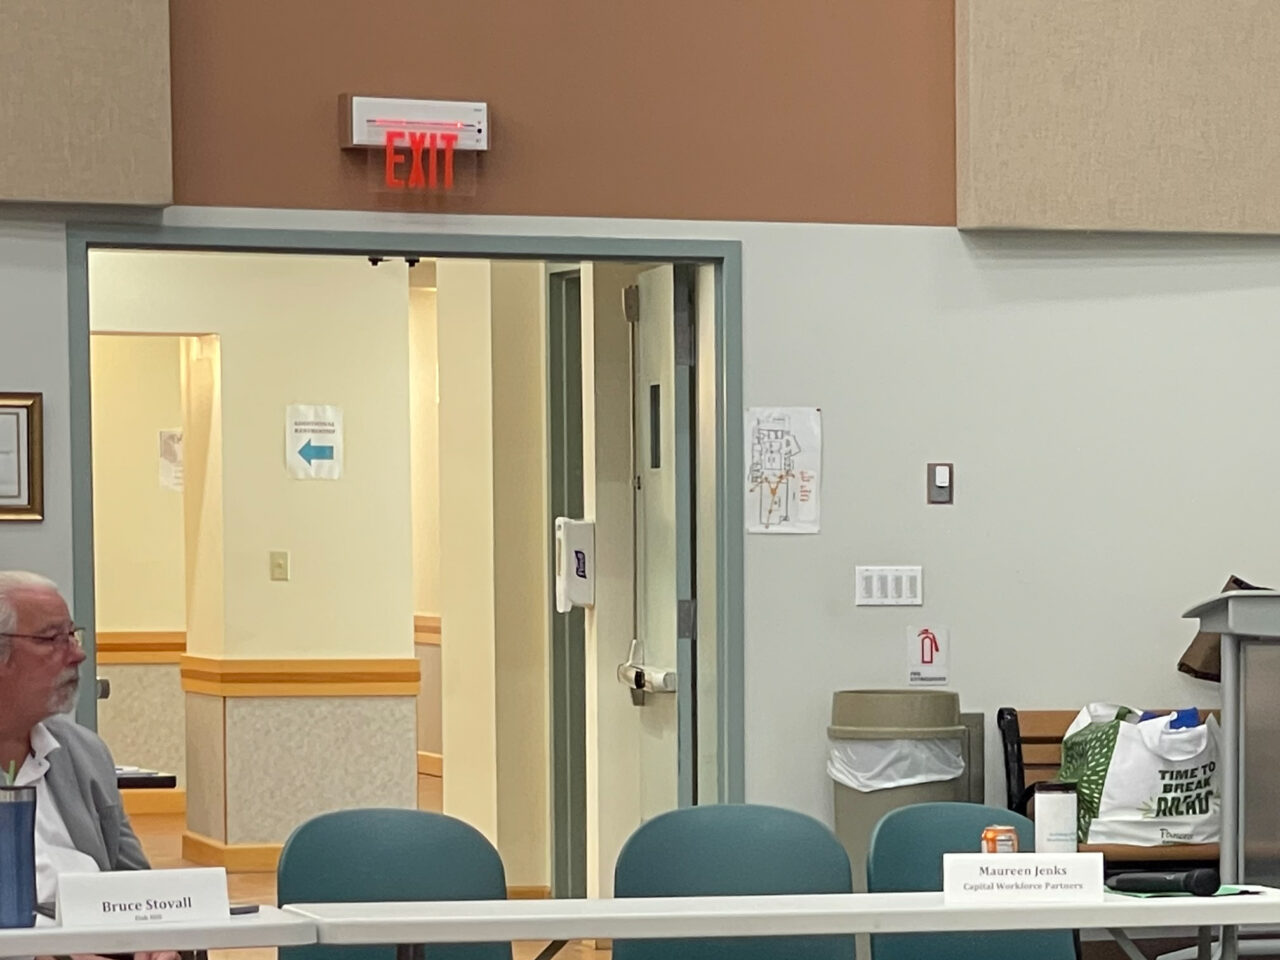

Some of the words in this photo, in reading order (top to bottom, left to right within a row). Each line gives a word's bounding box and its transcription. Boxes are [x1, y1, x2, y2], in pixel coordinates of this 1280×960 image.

[386, 131, 458, 190] EXIT
[1158, 768, 1198, 781] TIME
[1201, 761, 1216, 776] TO
[1162, 775, 1211, 794] BREAK
[979, 866, 1031, 877] Maureen
[1035, 865, 1067, 877] Jenks
[963, 882, 994, 892] Capital
[996, 882, 1042, 890] Workforce
[1044, 882, 1083, 890] Partners
[102, 901, 142, 913] Bruce
[145, 896, 192, 911] Stovall
